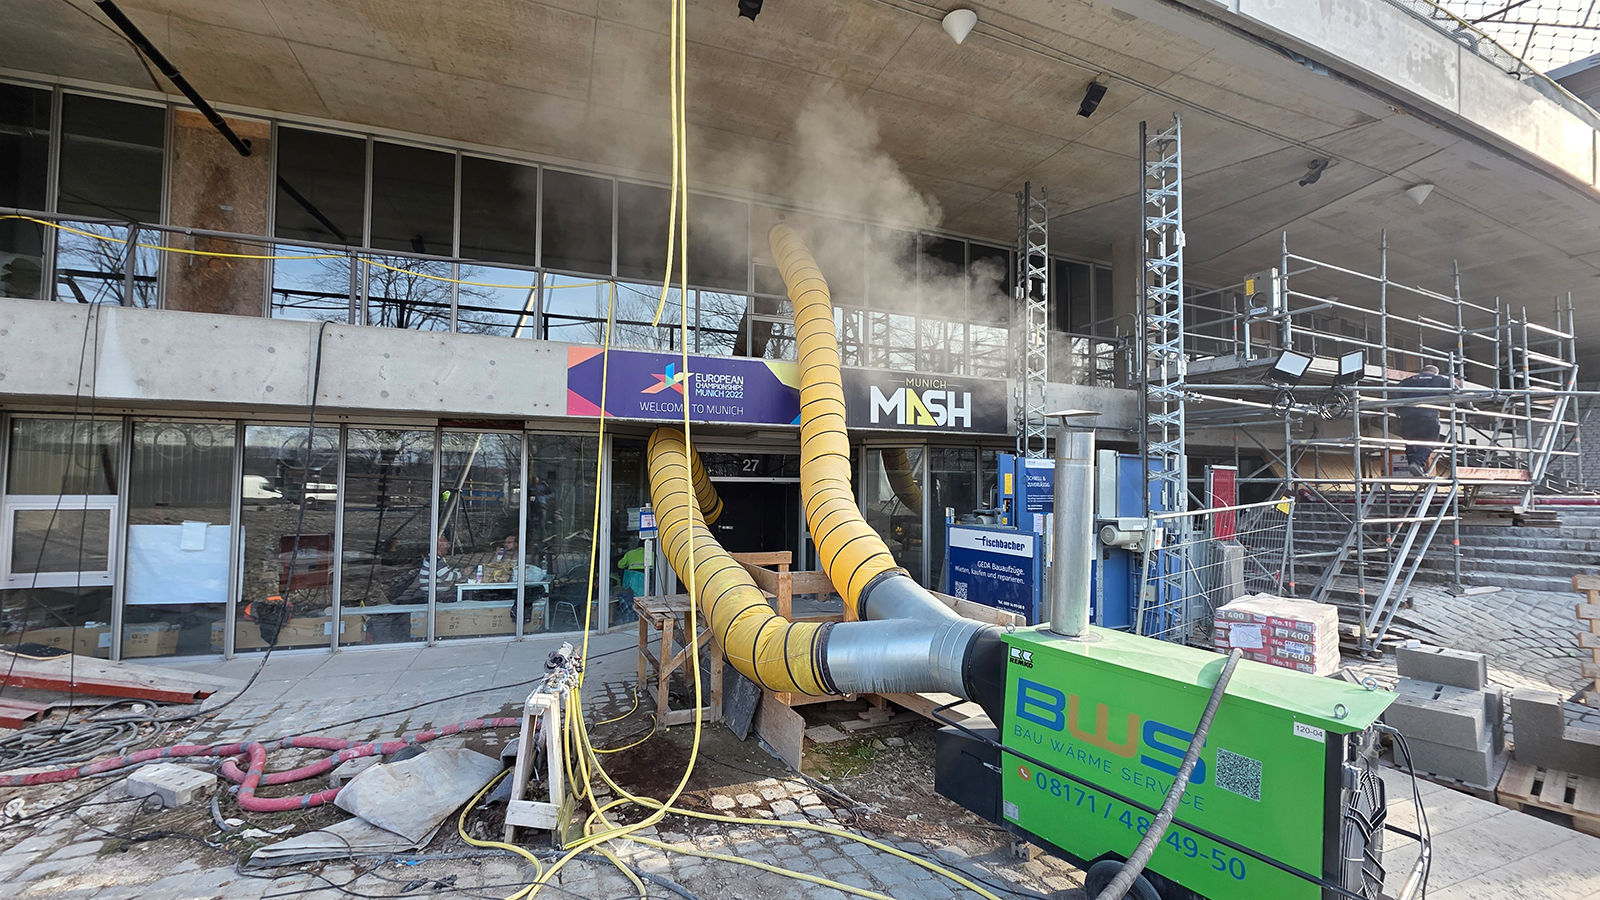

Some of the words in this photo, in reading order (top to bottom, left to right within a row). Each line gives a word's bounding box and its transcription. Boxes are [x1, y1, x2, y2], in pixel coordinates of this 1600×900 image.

[695, 373, 743, 385] EUROPEAN
[905, 377, 947, 389] MUNICH
[695, 382, 743, 391] CHAMPIONSHIPS
[695, 389, 724, 398] MUNICH
[725, 390, 743, 399] 2022
[639, 401, 689, 412] WELCOM
[692, 403, 704, 414] TO
[706, 405, 743, 415] MUNICH
[870, 386, 971, 427] MASH
[742, 459, 759, 471] 27
[975, 536, 1025, 551] fischbacher
[977, 561, 991, 569] GEDA
[971, 567, 987, 577] kaufen
[1228, 612, 1244, 620] 400
[1291, 632, 1310, 641] 400
[1010, 657, 1033, 669] REMKO
[1016, 677, 1206, 785] BWS
[1296, 725, 1323, 737] 120-04
[1014, 724, 1043, 745] BAU
[1050, 738, 1113, 774] WÄRME
[1121, 767, 1205, 811] SERVCE
[1036, 772, 1095, 813] 08171
[1104, 803, 1113, 819] /
